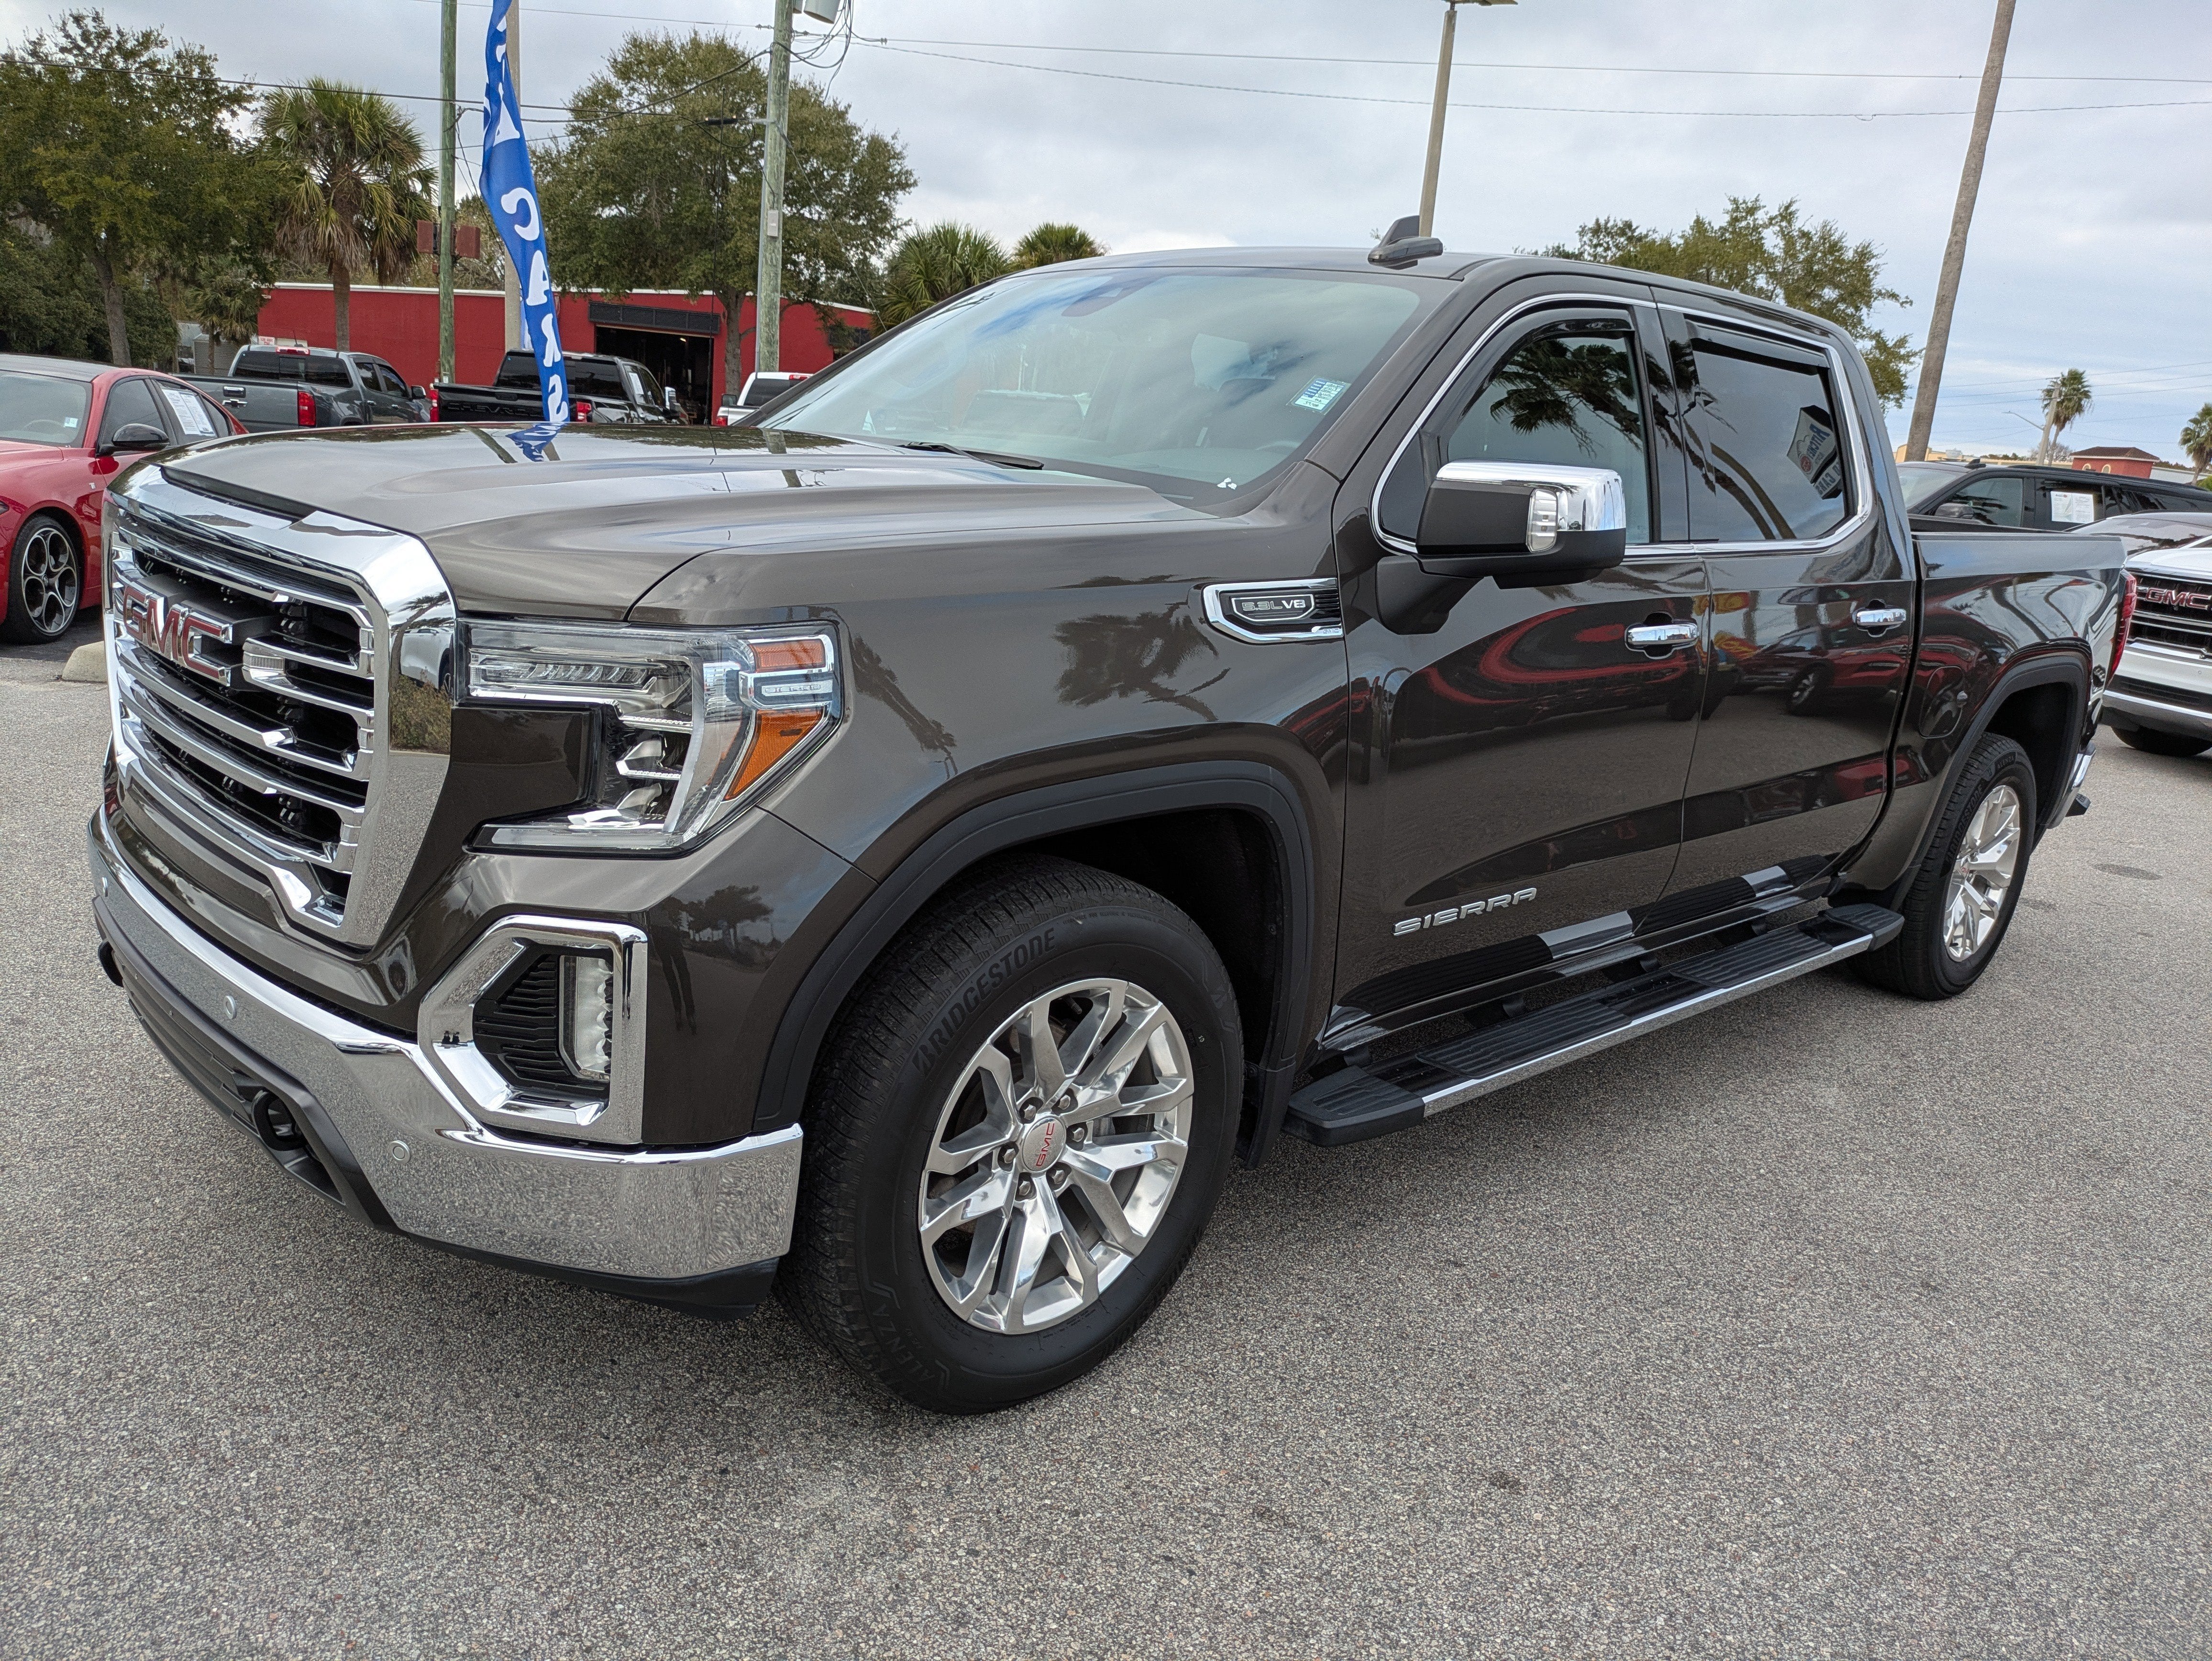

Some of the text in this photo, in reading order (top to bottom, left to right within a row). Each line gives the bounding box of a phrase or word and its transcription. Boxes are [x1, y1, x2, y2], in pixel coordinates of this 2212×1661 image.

[2145, 587, 2212, 610] GMC
[123, 582, 233, 687] GMC
[765, 684, 821, 693] SIERRA
[1392, 887, 1537, 936] SIERRA
[911, 927, 1055, 1074] BRIDGESTONE
[1036, 1122, 1055, 1167] GMC
